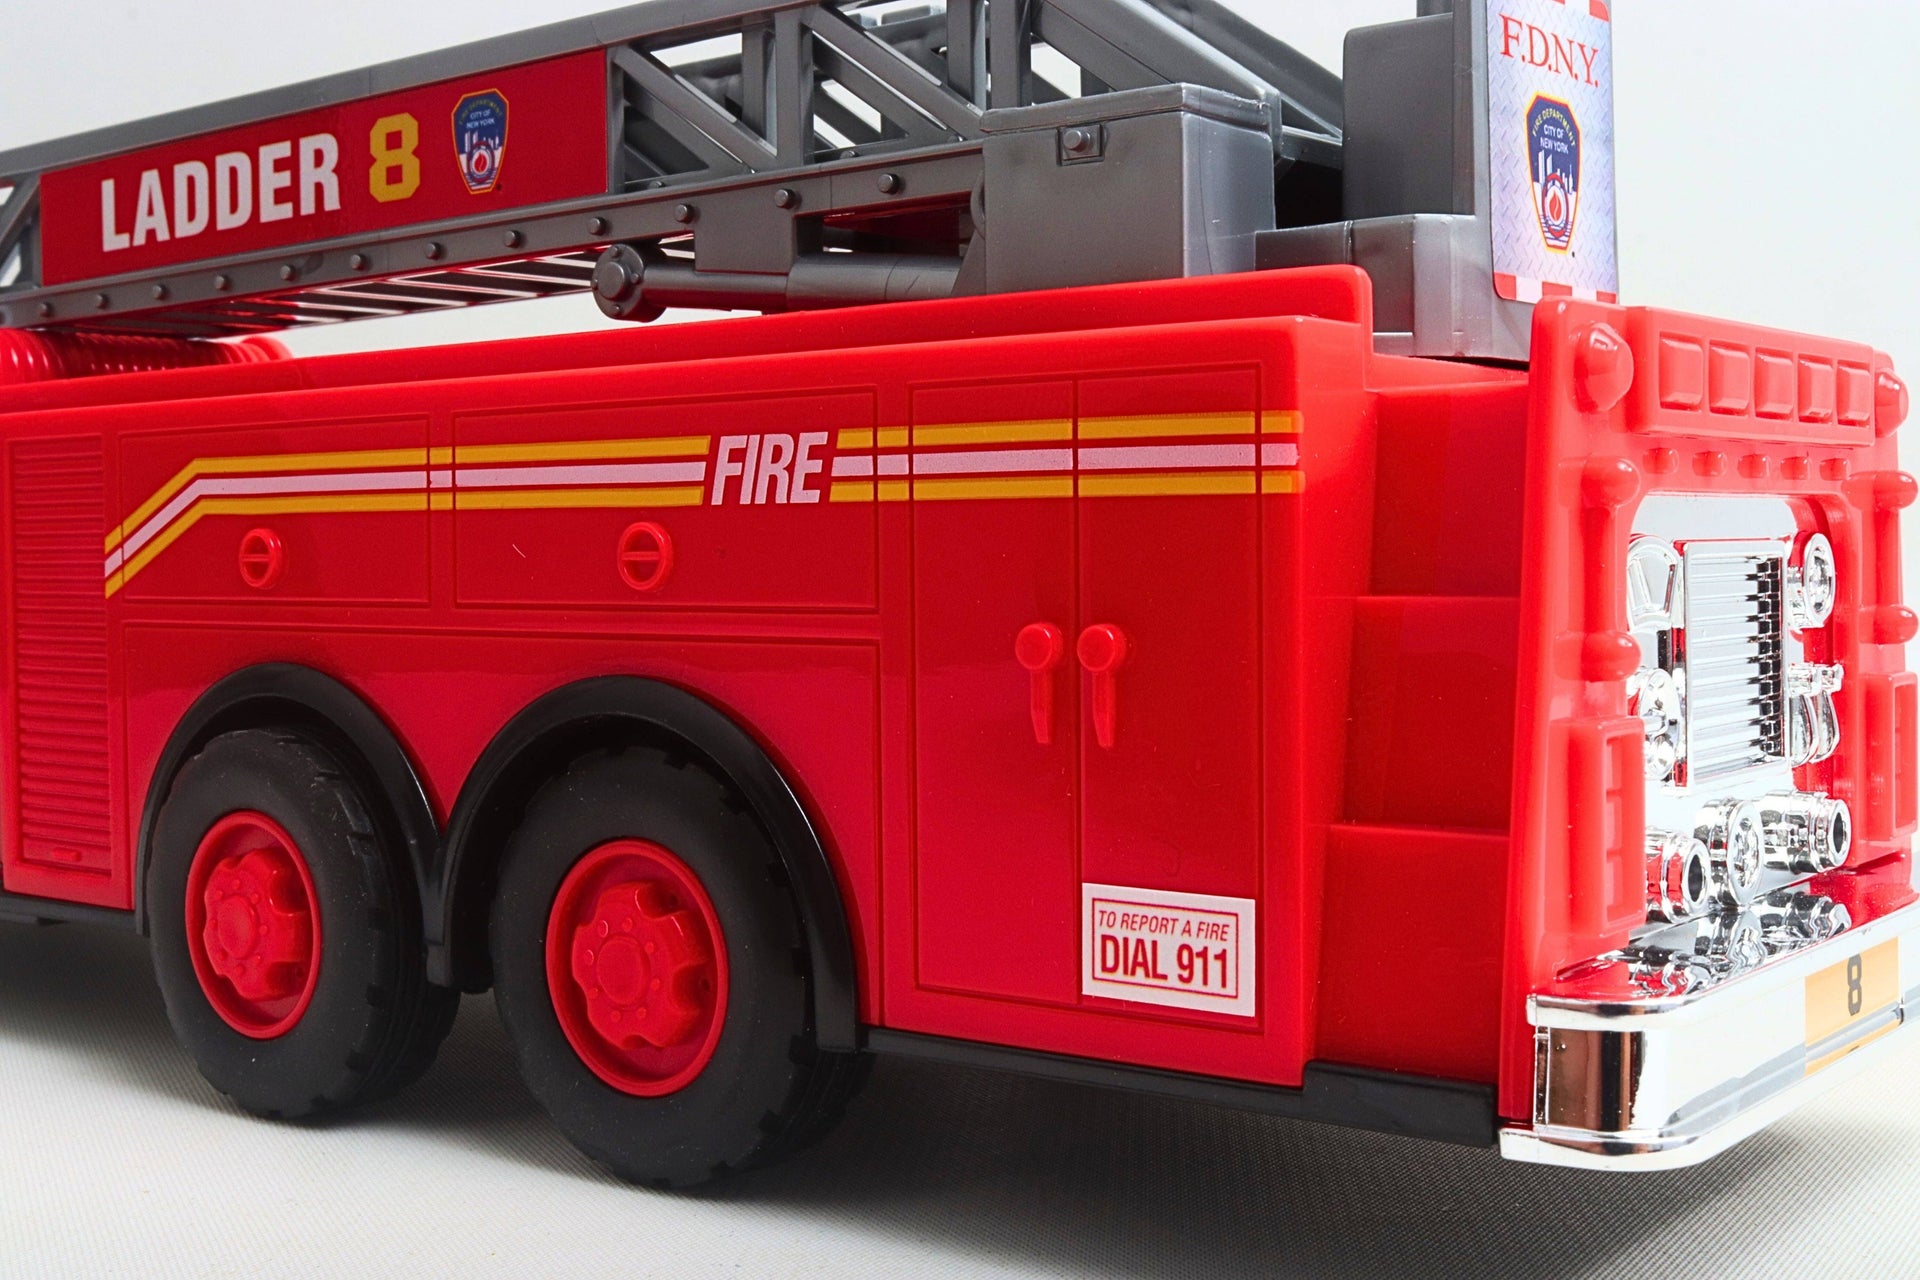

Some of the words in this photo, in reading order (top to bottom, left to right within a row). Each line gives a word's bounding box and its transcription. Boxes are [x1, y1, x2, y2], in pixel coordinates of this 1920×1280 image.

[1499, 13, 1599, 87] F.D.N.Y.
[466, 121, 479, 129] NEW
[479, 118, 495, 126] YORK
[470, 111, 482, 119] CITY
[483, 108, 491, 117] OF
[1532, 115, 1543, 137] FIRE
[1542, 108, 1576, 147] DEPARTMENT
[1543, 124, 1556, 136] CITY
[1556, 128, 1565, 139] OF
[1540, 137, 1553, 149] NEW
[1553, 141, 1569, 154] YORK
[101, 132, 341, 252] LADDER
[369, 112, 421, 203] 8
[711, 431, 828, 506] FIRE
[1098, 910, 1117, 928] TO
[1120, 912, 1179, 935] REPORT
[1180, 920, 1192, 937] A
[1196, 921, 1230, 942] FIRE
[1101, 934, 1168, 981] DIAL
[1176, 943, 1227, 989] 911
[1847, 953, 1862, 1016] 8
